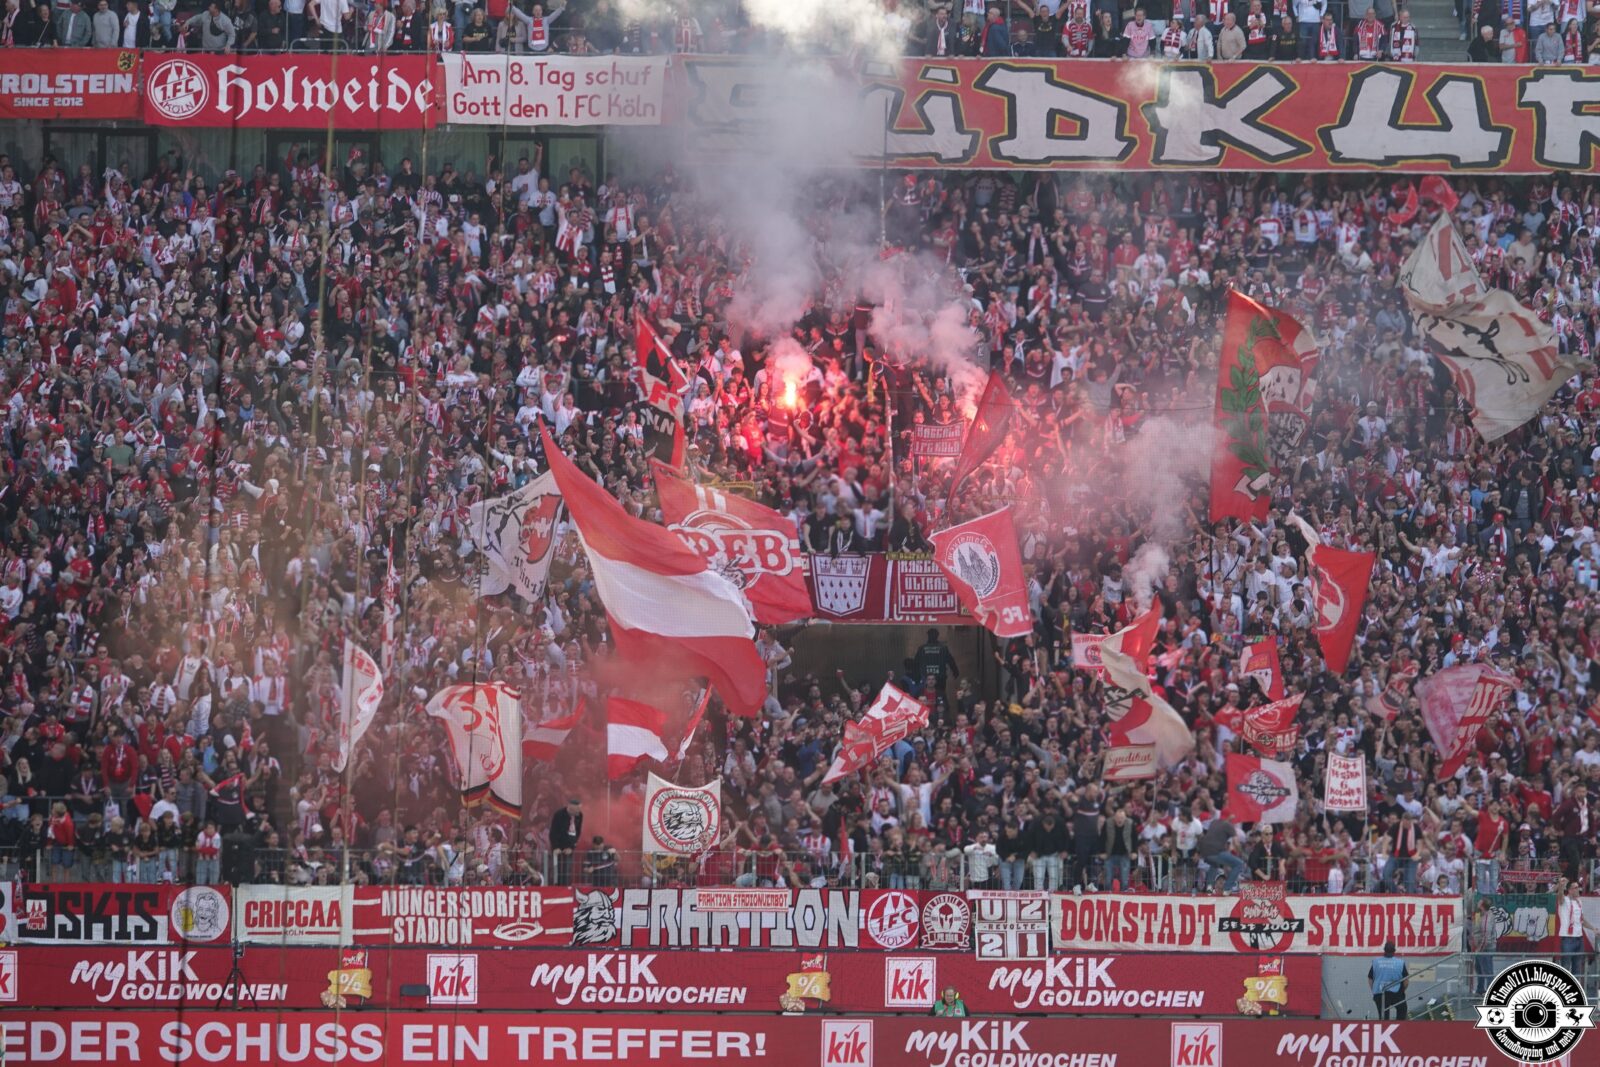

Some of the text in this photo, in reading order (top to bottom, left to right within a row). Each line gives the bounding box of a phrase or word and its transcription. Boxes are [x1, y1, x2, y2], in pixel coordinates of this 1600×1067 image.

[0, 74, 133, 94] ROLSTEIN
[463, 62, 652, 91] Am 8. Tag schuf
[14, 97, 84, 107] SINCE 2012
[215, 63, 433, 120] Holweide
[453, 93, 656, 118] Gott den 1. FC Köln
[381, 886, 543, 918] MÜNGERSDORFER
[698, 893, 732, 906] FRAKTION
[245, 899, 342, 928] CRICCAA
[1061, 899, 1216, 946] DOMSTADT
[1307, 903, 1455, 947] SYNDIKAT
[393, 916, 472, 945] STADION
[988, 923, 1036, 931] REVOLTE
[121, 983, 287, 1001] GOLDWOCHEN
[580, 986, 746, 1004] GOLDWOCHEN
[1039, 989, 1205, 1008] GOLDWOCHEN
[159, 1020, 384, 1062] SCHUSS
[403, 1023, 489, 1061] EIN
[507, 1026, 766, 1061] TREFFER!
[954, 1053, 1117, 1067] GOLDWOCHEN
